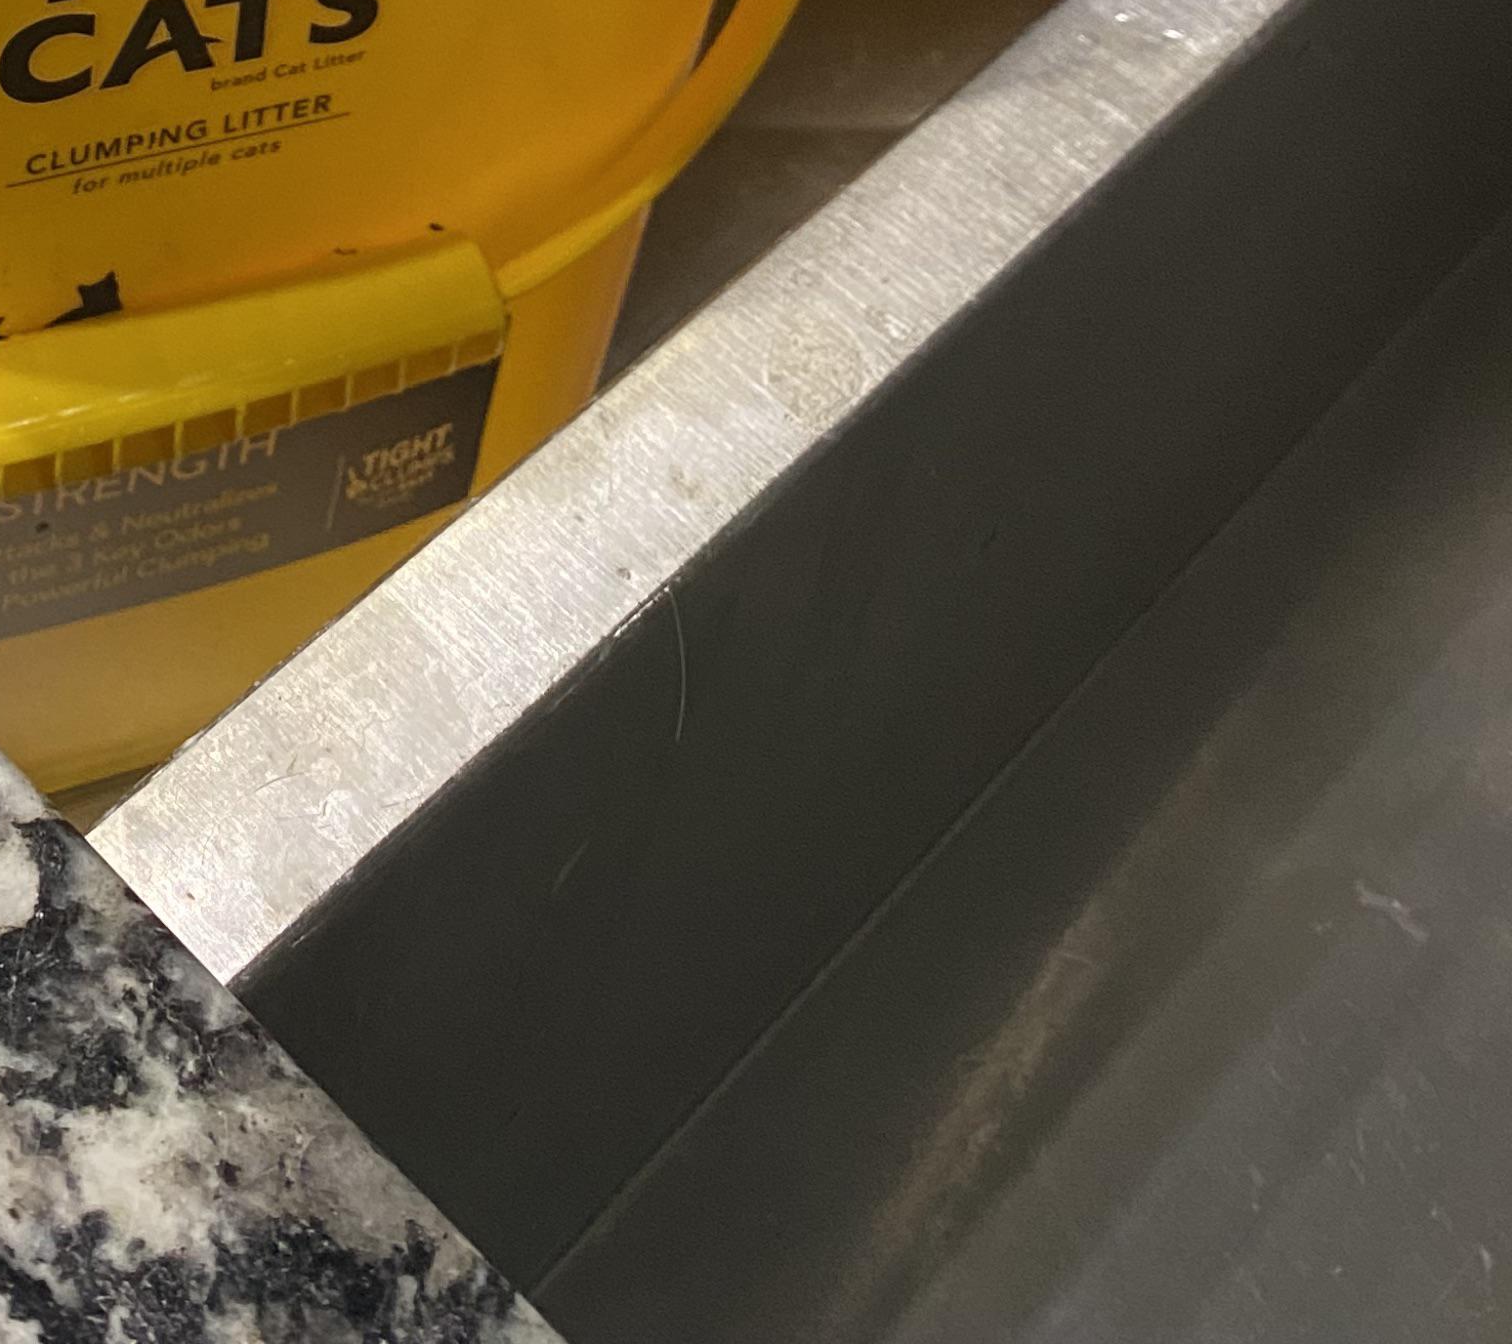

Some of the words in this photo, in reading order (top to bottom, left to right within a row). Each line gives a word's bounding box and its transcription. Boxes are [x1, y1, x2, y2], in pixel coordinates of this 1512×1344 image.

[210, 67, 268, 92] brand
[273, 61, 308, 79] Cat
[314, 51, 367, 72] Litter
[25, 119, 209, 175] CLUMPING
[223, 94, 333, 135] LITTER
[72, 177, 107, 195] for
[119, 150, 222, 186] multiple
[231, 139, 283, 161] cats
[363, 422, 453, 476] TIGHT
[155, 516, 243, 548] Odors
[2, 567, 129, 612] Powerful
[137, 532, 270, 579] Clumping
